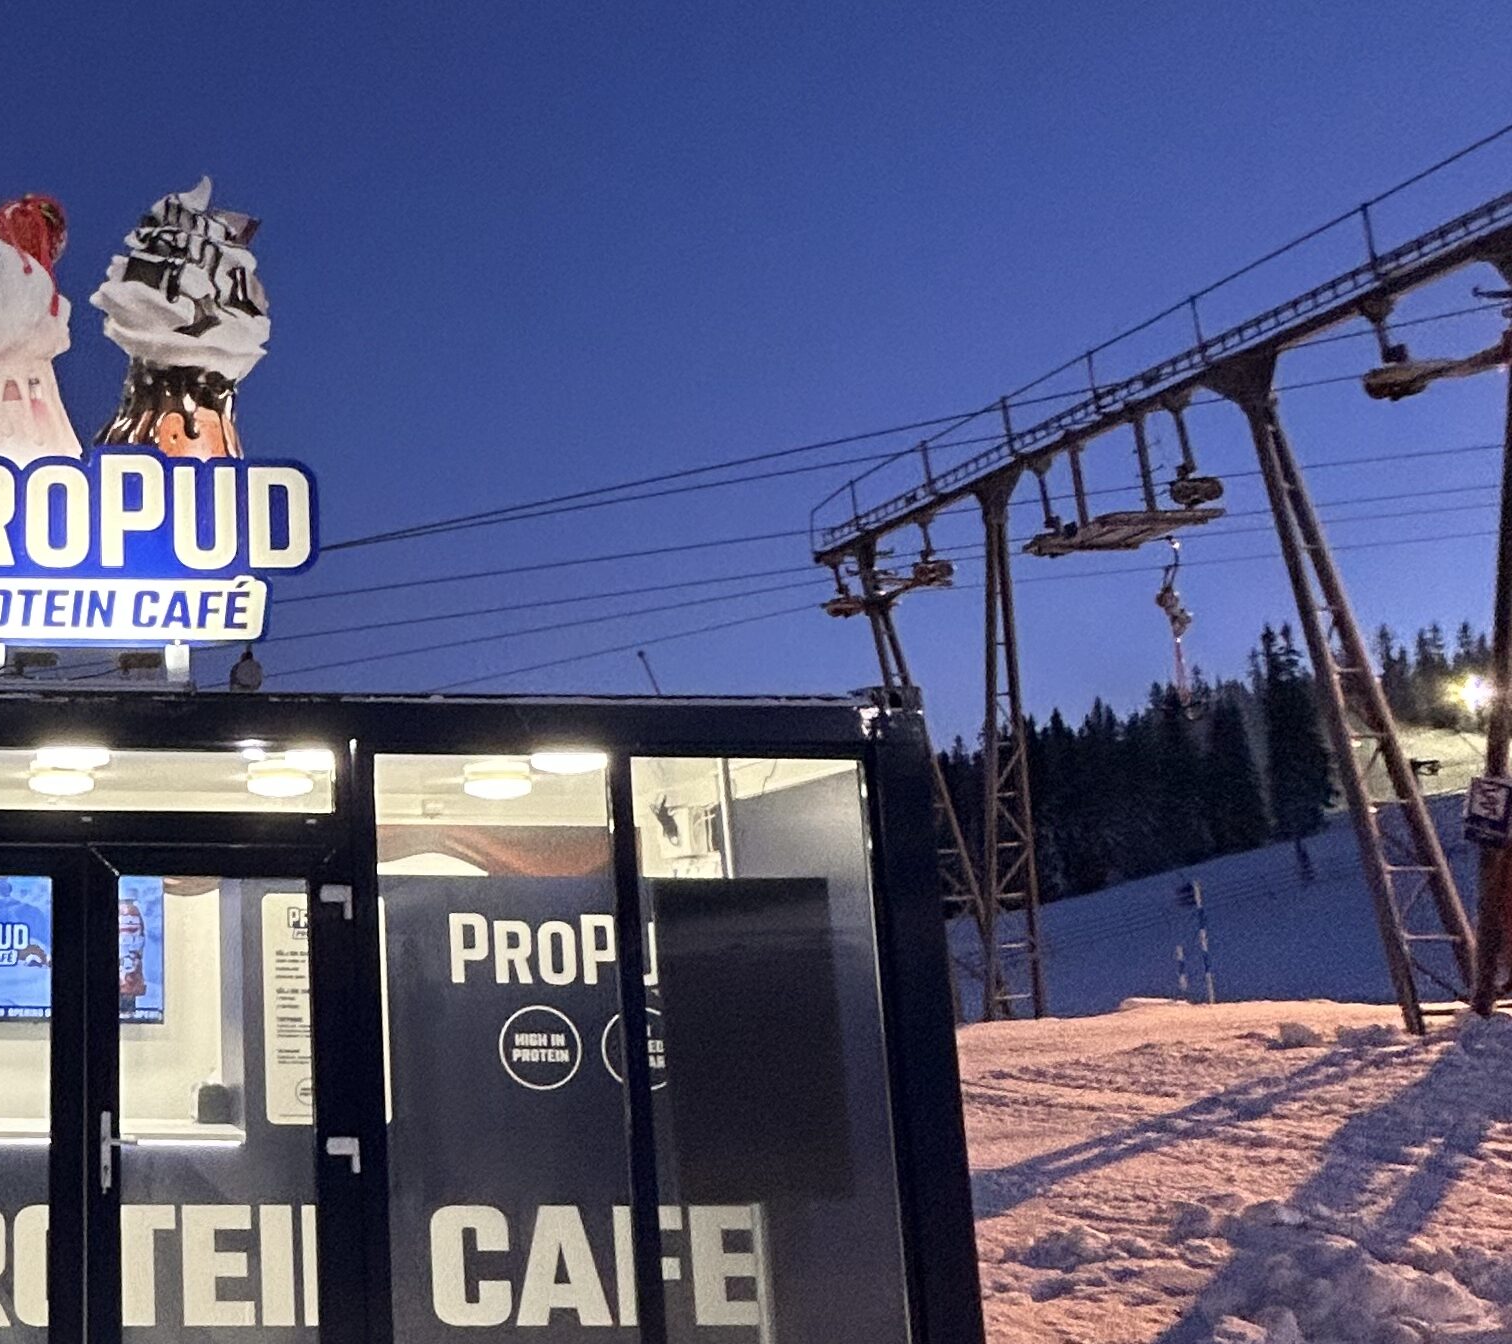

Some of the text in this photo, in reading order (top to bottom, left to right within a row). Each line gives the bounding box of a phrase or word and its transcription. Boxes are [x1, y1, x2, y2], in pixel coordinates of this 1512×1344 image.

[131, 581, 250, 630] CAFÉ
[512, 1048, 570, 1063] PROTEIN
[514, 1033, 565, 1047] HIGH IN
[429, 1204, 760, 1327] CAFE
